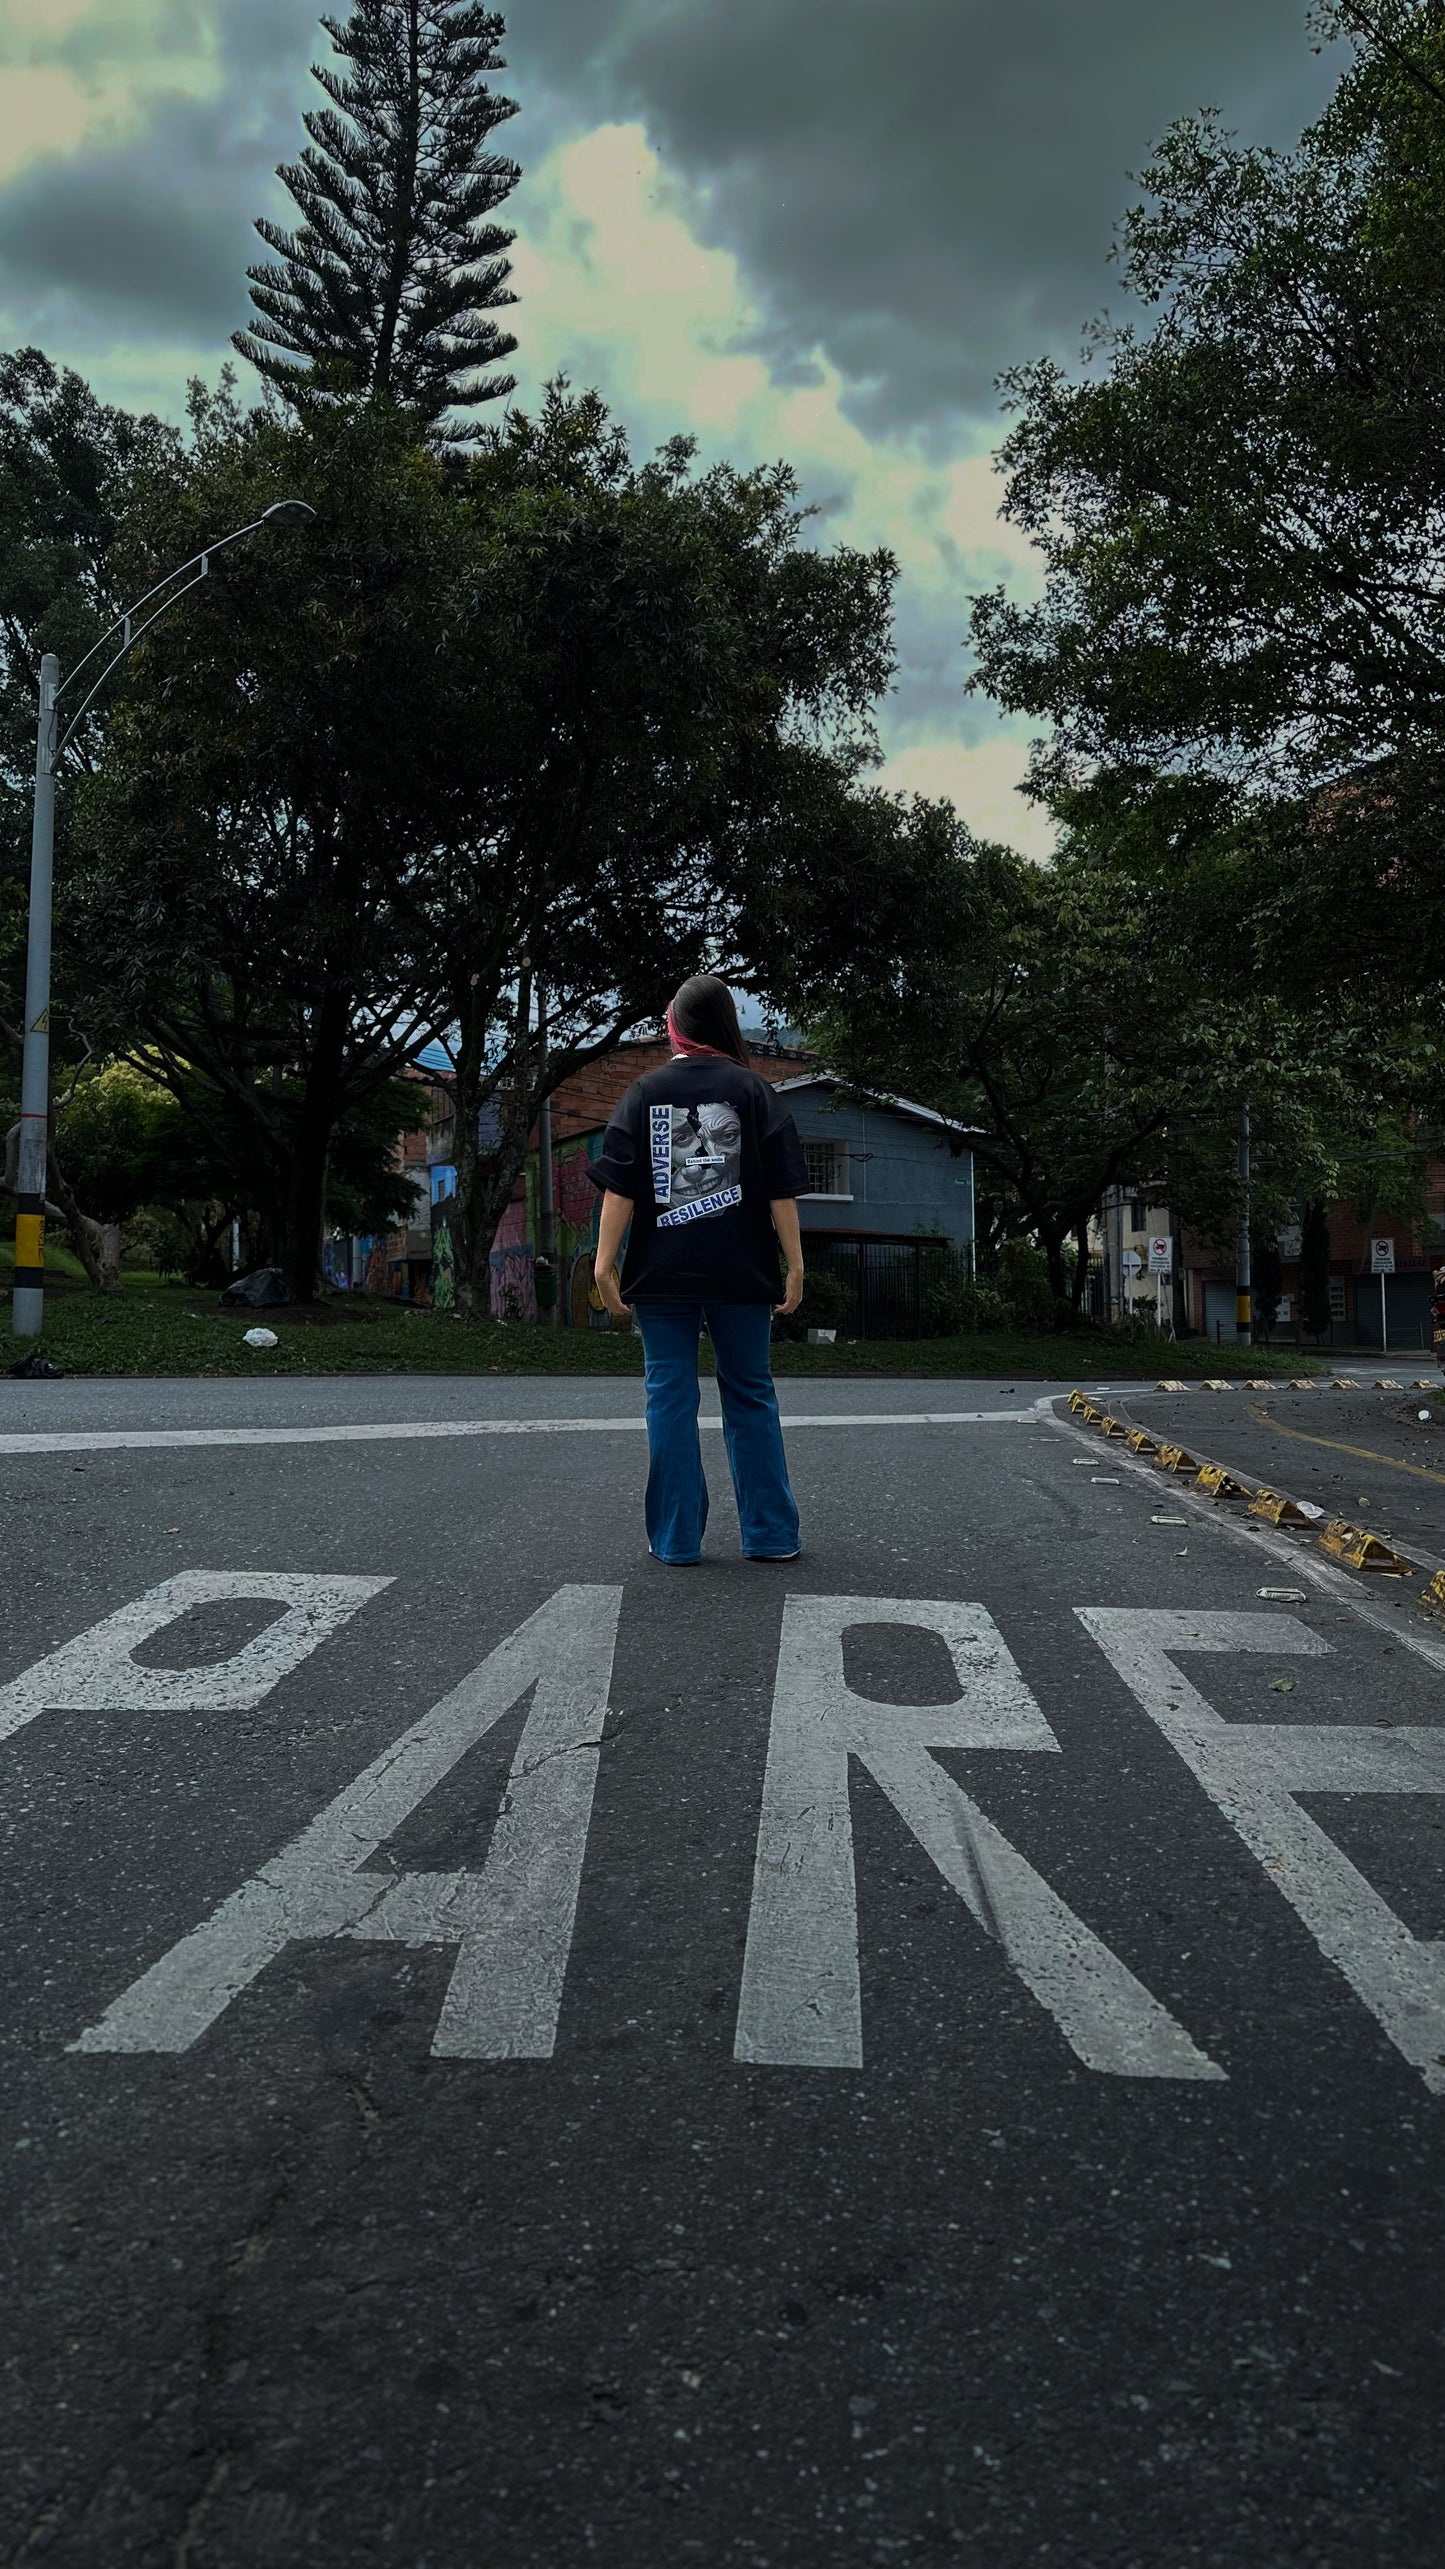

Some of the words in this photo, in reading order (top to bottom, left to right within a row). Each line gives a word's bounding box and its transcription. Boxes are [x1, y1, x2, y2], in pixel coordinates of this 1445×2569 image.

[652, 1107, 670, 1198] ADVERSE
[660, 1187, 739, 1227] RESILENCE
[0, 1571, 1445, 2096] PARE
